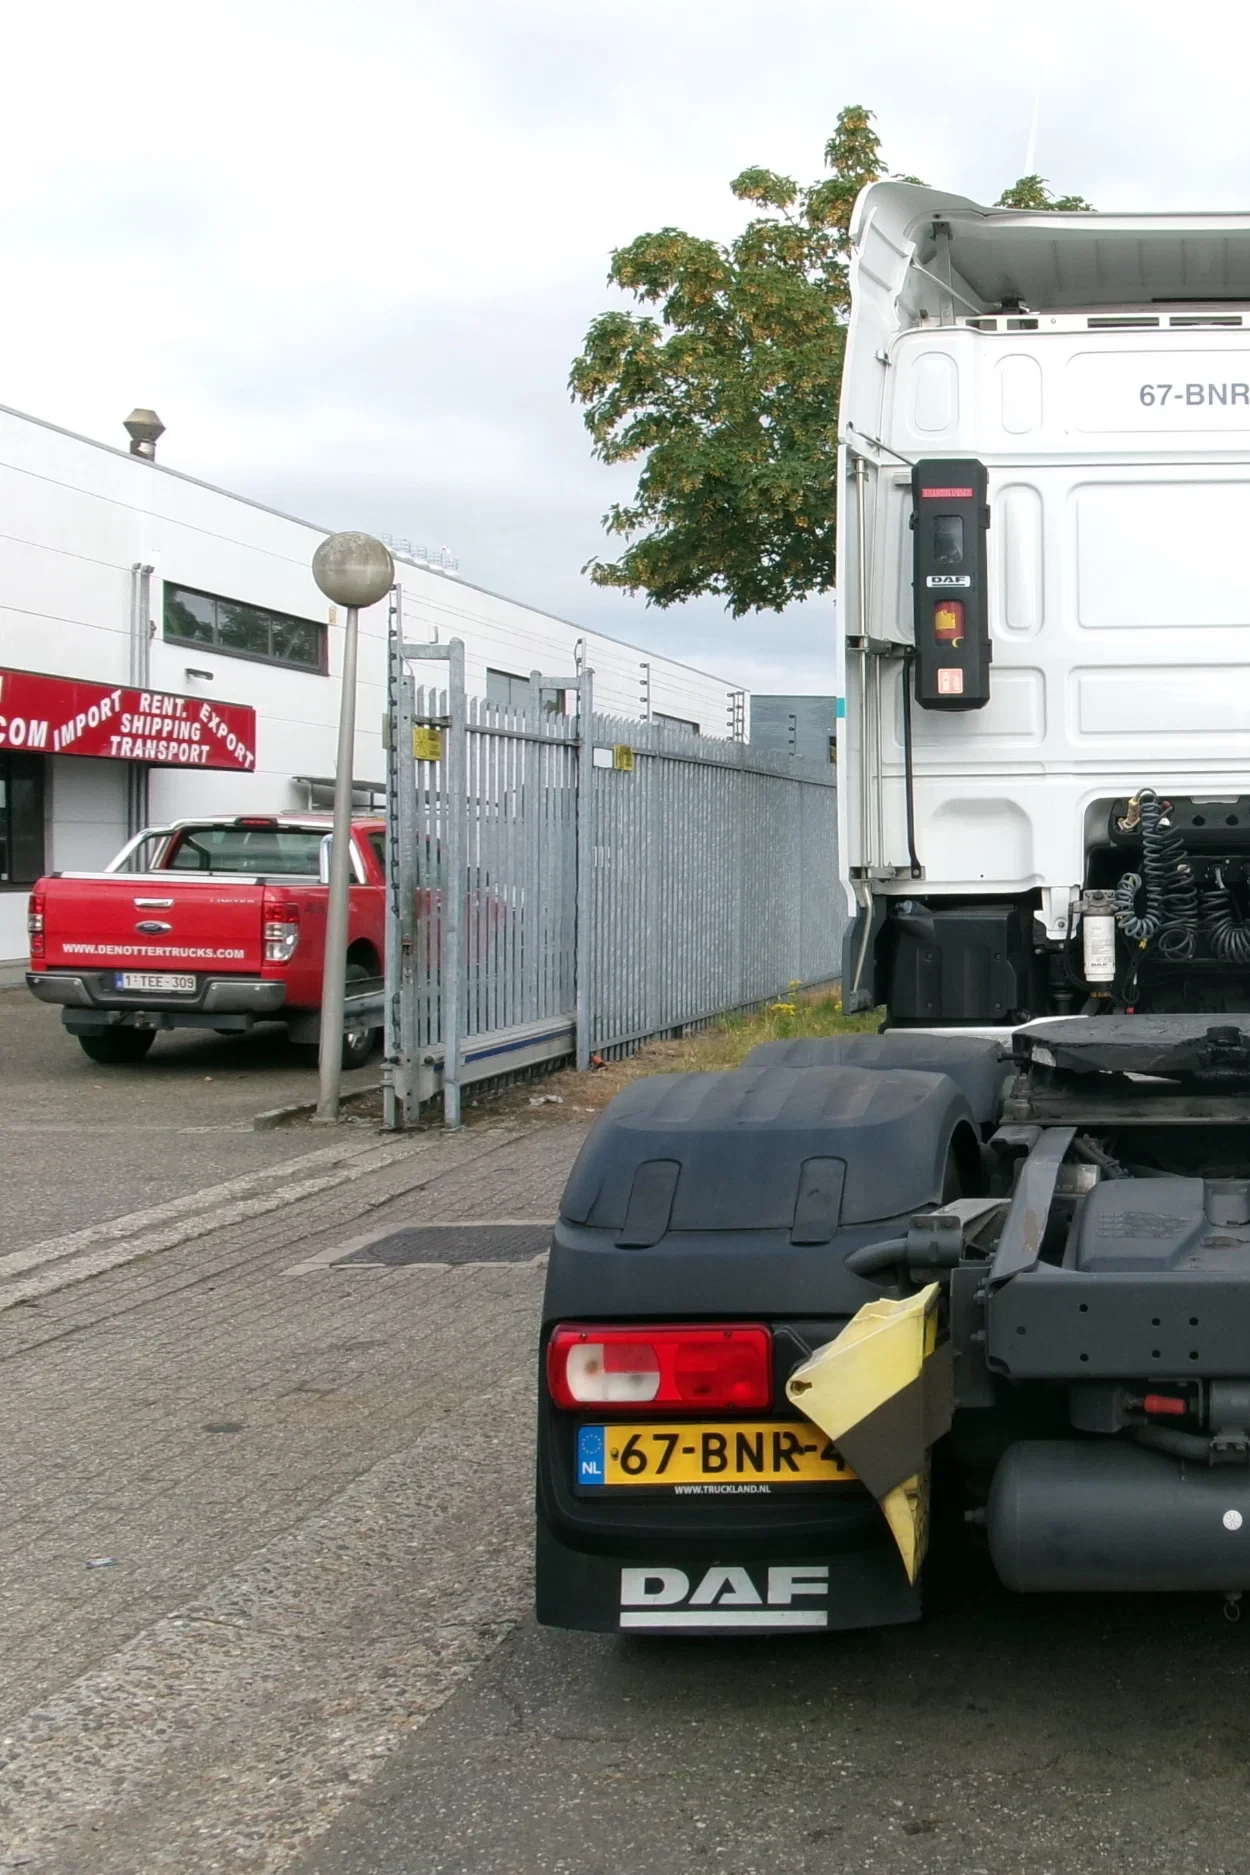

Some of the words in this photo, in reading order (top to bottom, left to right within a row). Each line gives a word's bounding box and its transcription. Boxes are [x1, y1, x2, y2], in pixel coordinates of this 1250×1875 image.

[139, 693, 187, 717] RENT.
[53, 689, 122, 751] IMPORT
[120, 714, 201, 741] SHIPPING
[199, 702, 254, 768] EXPORT
[110, 736, 210, 763] TRANSPORT
[62, 943, 244, 959] WWW.DENOTTERTRUCKS.COM
[125, 975, 195, 988] 1-TEE-309
[582, 1461, 601, 1475] NL
[674, 1485, 772, 1495] WWW.TRUCKLAND.NL
[620, 1566, 829, 1605] DAF
